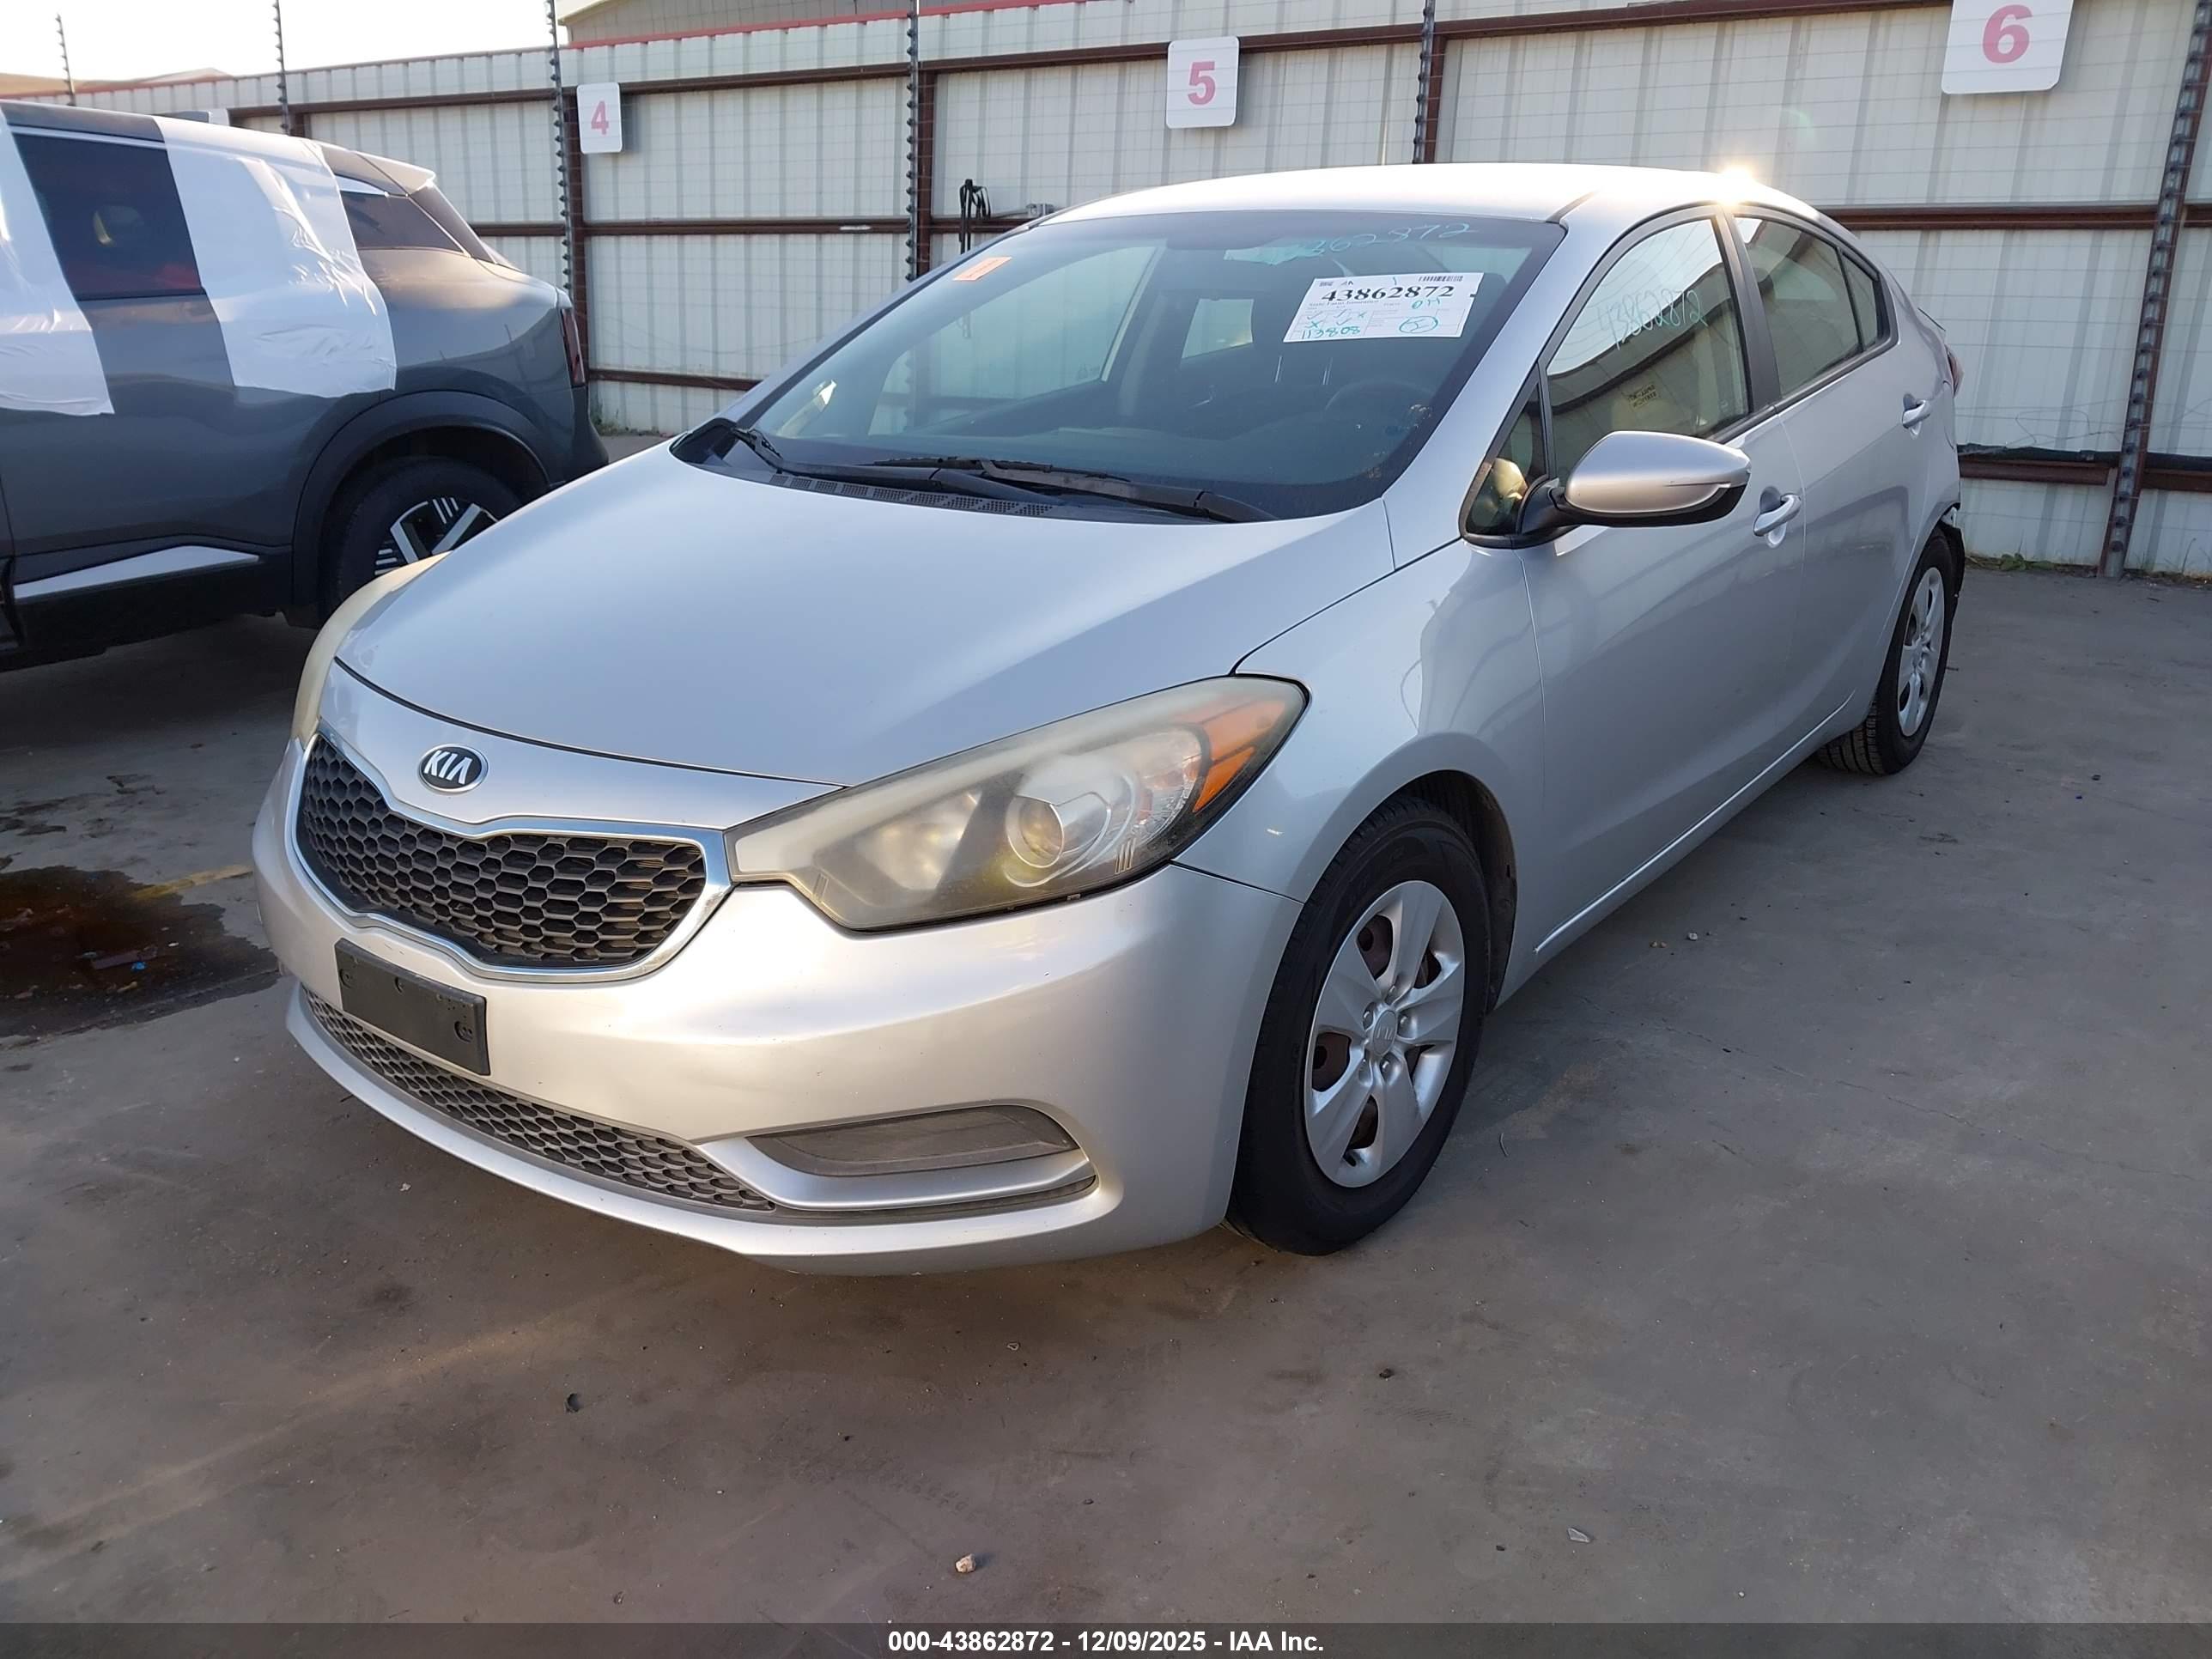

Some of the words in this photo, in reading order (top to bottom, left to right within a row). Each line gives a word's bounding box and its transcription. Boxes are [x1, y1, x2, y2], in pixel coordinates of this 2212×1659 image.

[1982, 3, 2033, 64] 6
[1188, 60, 1216, 106] 5
[590, 100, 610, 136] 4
[1321, 285, 1455, 301] 43862872
[423, 750, 473, 785] KIA
